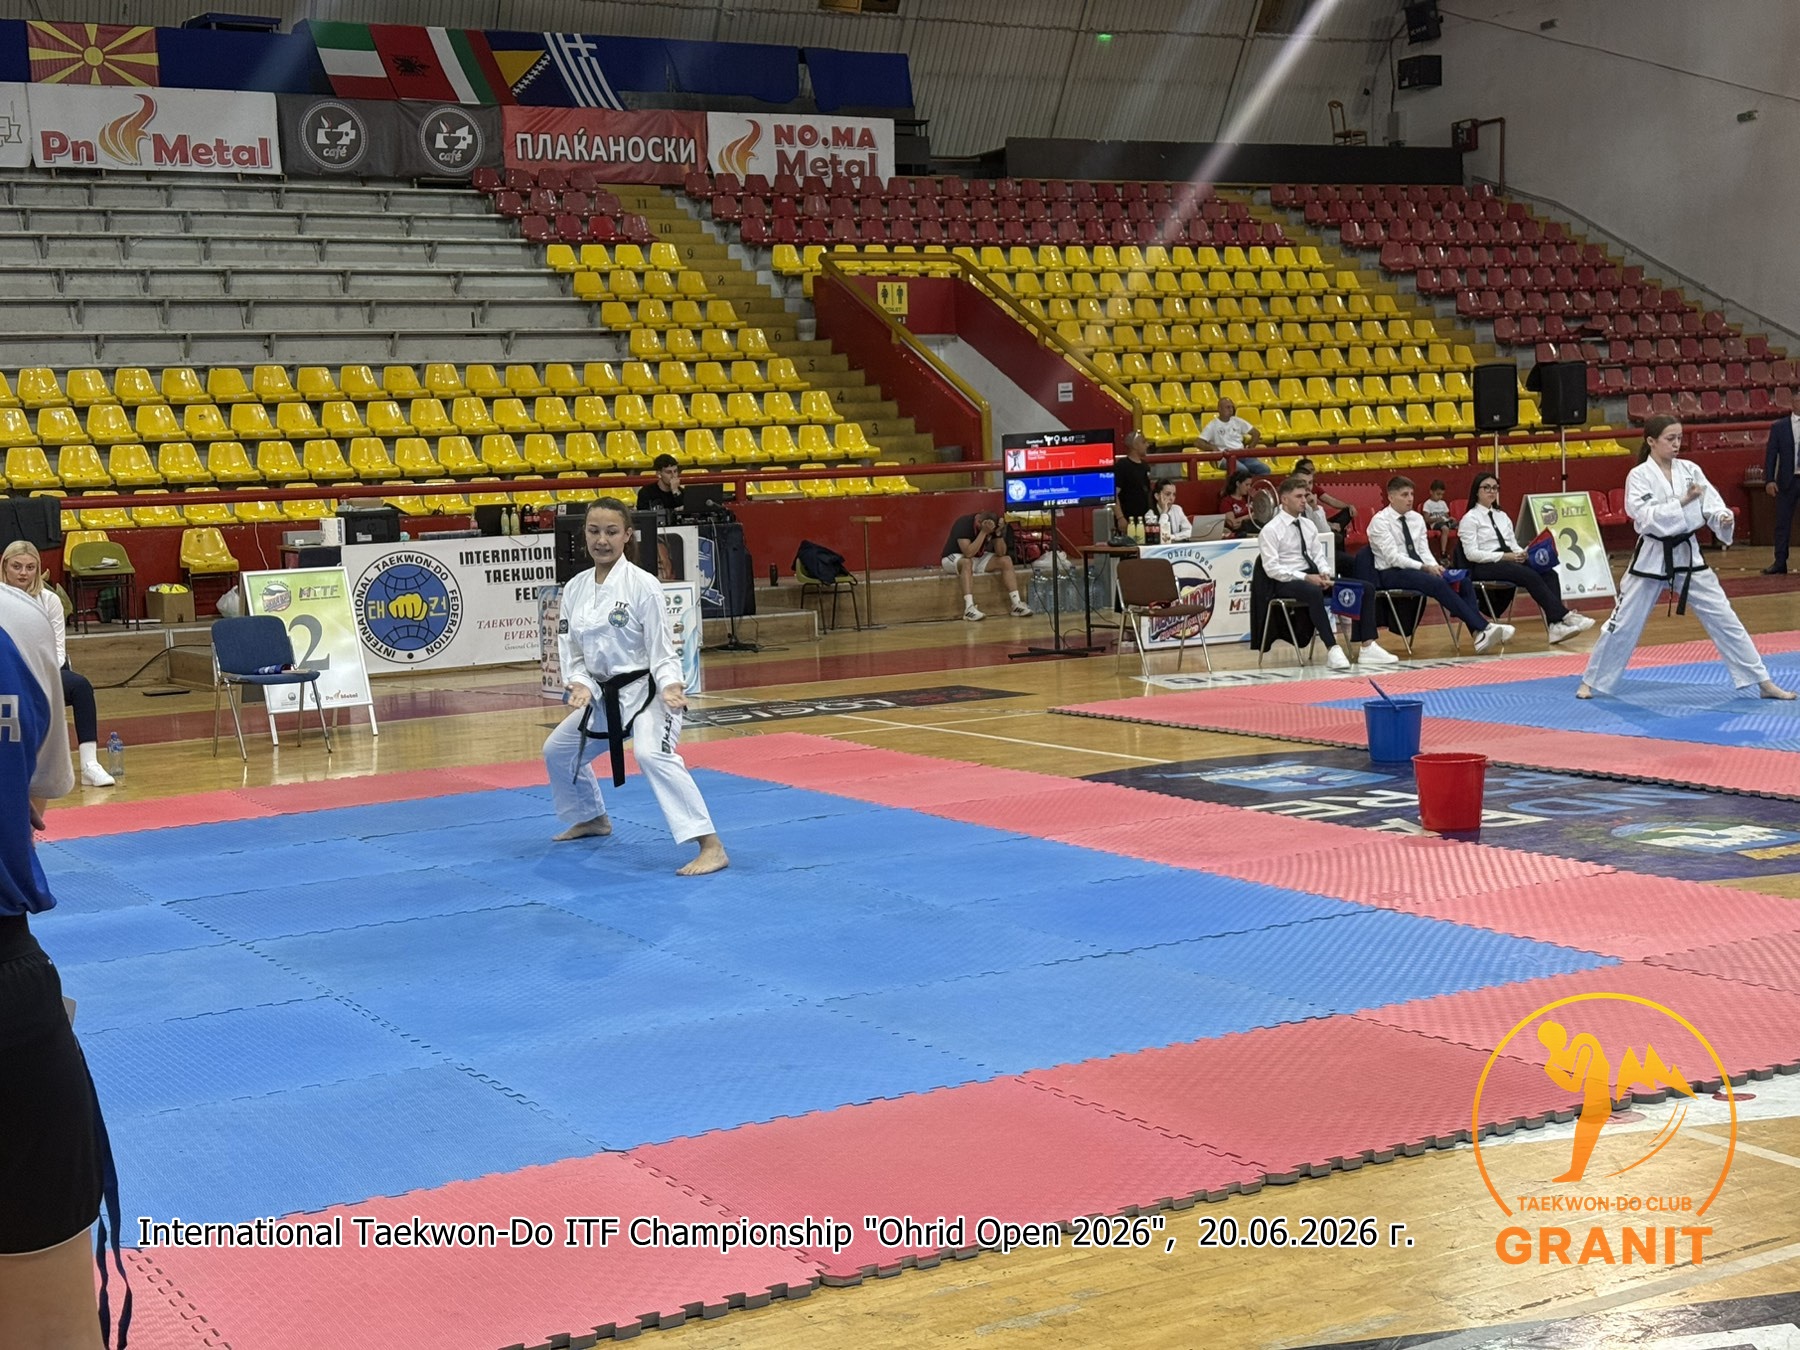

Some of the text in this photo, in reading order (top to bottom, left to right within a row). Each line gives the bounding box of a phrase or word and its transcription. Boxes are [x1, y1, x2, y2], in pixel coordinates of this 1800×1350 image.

[40, 130, 271, 169] Pn Metal
[515, 127, 697, 164] ПЛАЌАНОСКИ
[323, 146, 347, 159] café
[438, 150, 462, 164] café
[776, 149, 878, 178] Metal
[658, 223, 672, 234] 10
[687, 248, 694, 260] 9
[717, 275, 725, 286] 8
[774, 329, 782, 341] 6
[808, 359, 816, 371] 5
[872, 423, 879, 436] 3
[459, 546, 556, 565] INTERNATION
[1167, 549, 1192, 560] Ohrid
[1559, 527, 1586, 571] 3
[485, 566, 554, 583] TAEKWON
[355, 554, 459, 658] INTERNATIONAL TAEKWON-DO FEDERATION
[615, 601, 629, 609] ITF
[476, 617, 540, 630] TAEKWON-
[288, 614, 330, 671] 2
